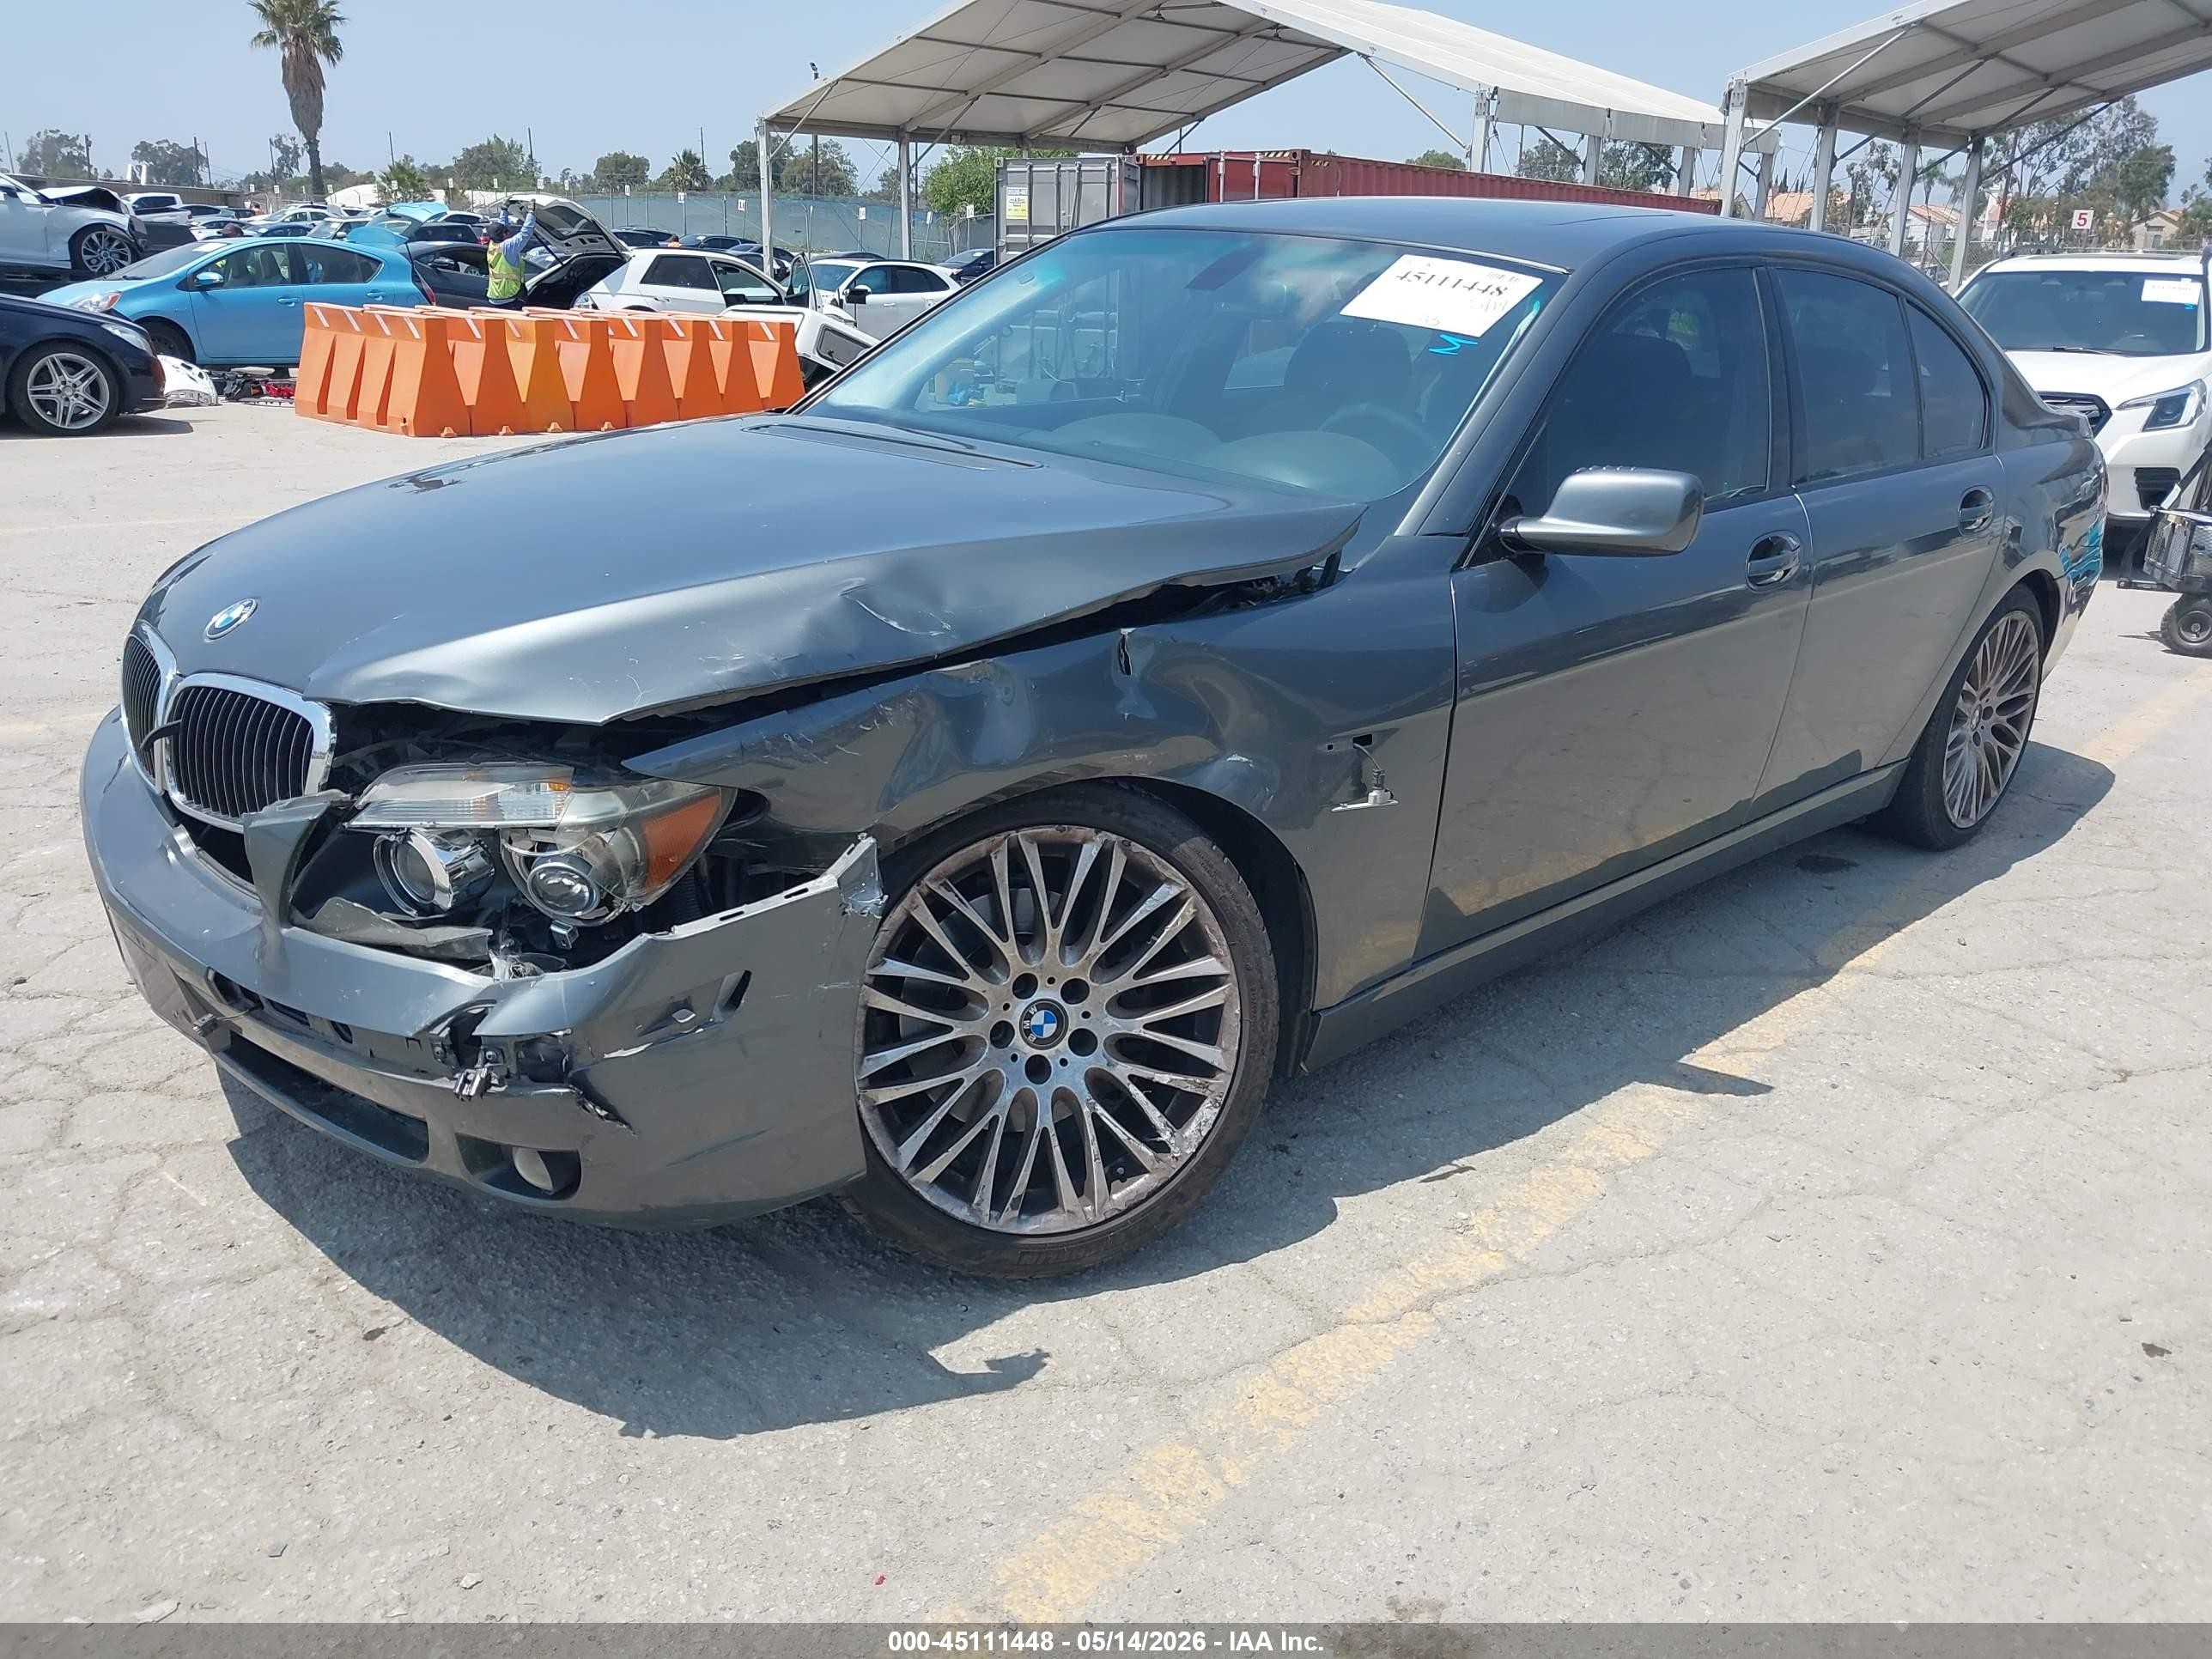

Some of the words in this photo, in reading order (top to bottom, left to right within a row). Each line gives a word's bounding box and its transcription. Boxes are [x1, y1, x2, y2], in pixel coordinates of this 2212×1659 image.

[2076, 213, 2087, 227] 5
[1395, 270, 1510, 297] 45111448
[1023, 1005, 1038, 1042] BMW
